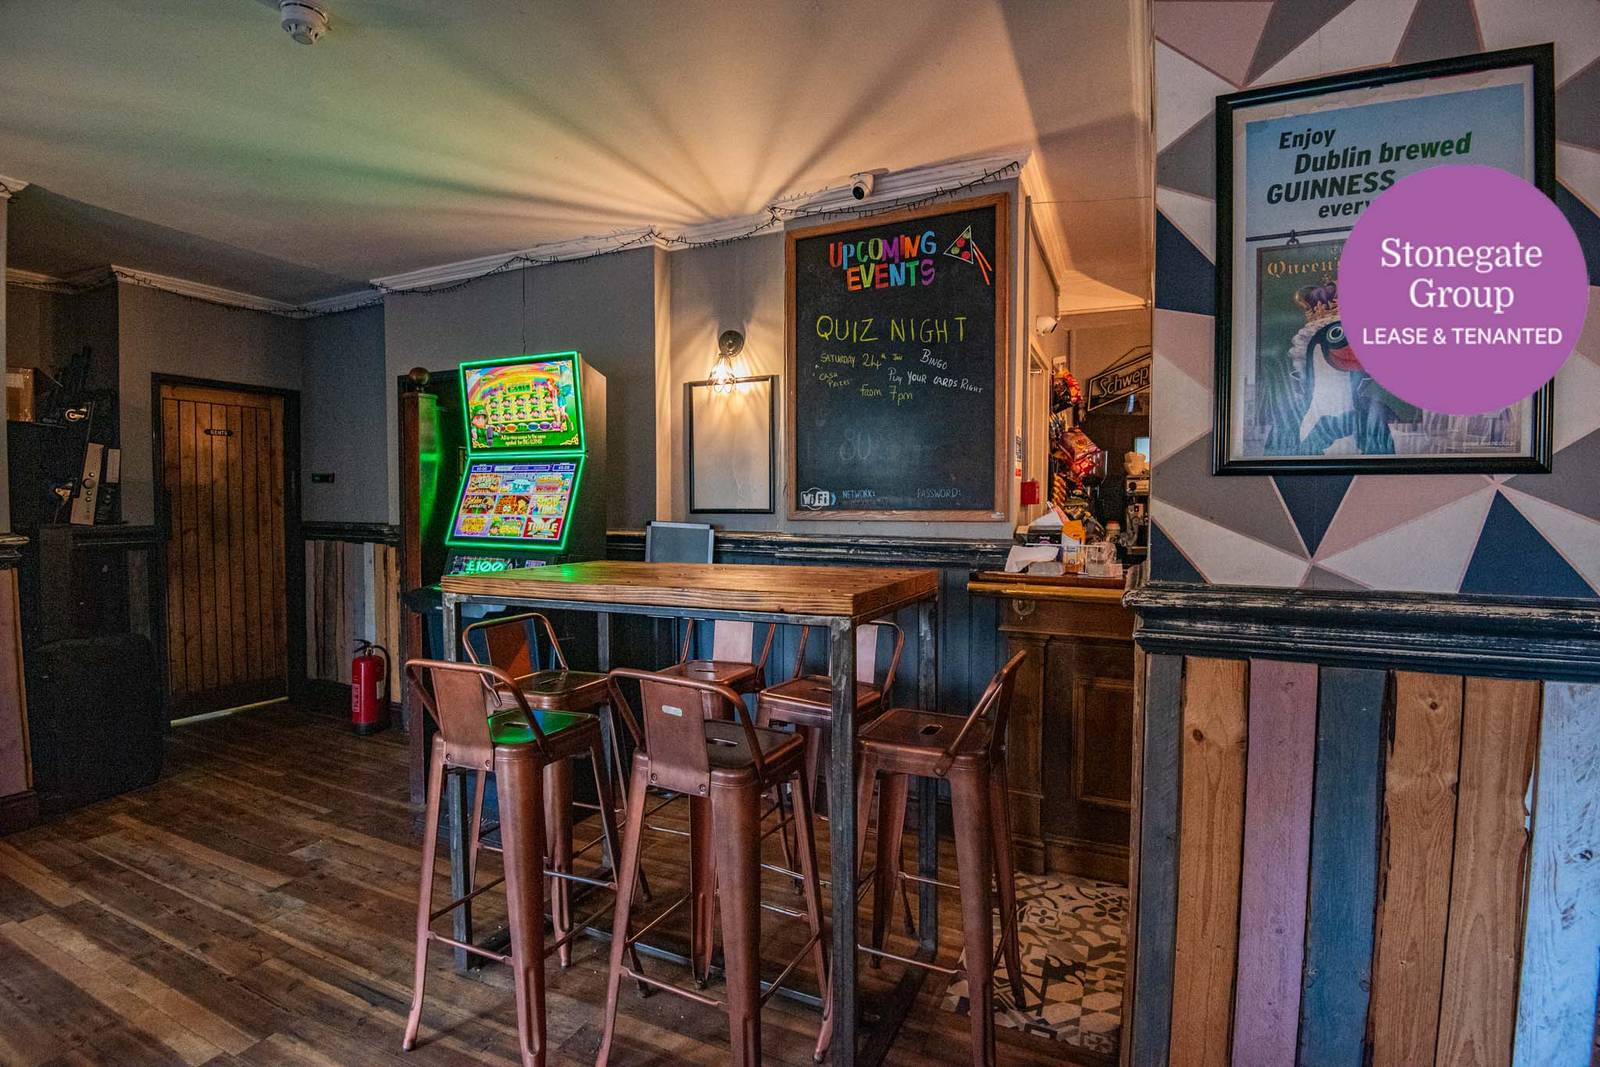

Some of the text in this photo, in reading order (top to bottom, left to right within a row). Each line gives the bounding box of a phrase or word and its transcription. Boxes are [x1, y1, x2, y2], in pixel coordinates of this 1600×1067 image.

[1279, 128, 1336, 150] Enjoy
[1294, 131, 1472, 175] Dublin brewed
[1267, 169, 1396, 205] GUINNESS
[829, 231, 937, 270] UPCOMING
[847, 259, 936, 292] EVENTS
[816, 315, 967, 343] QUIZ NIGHT
[1099, 364, 1150, 398] Schwep
